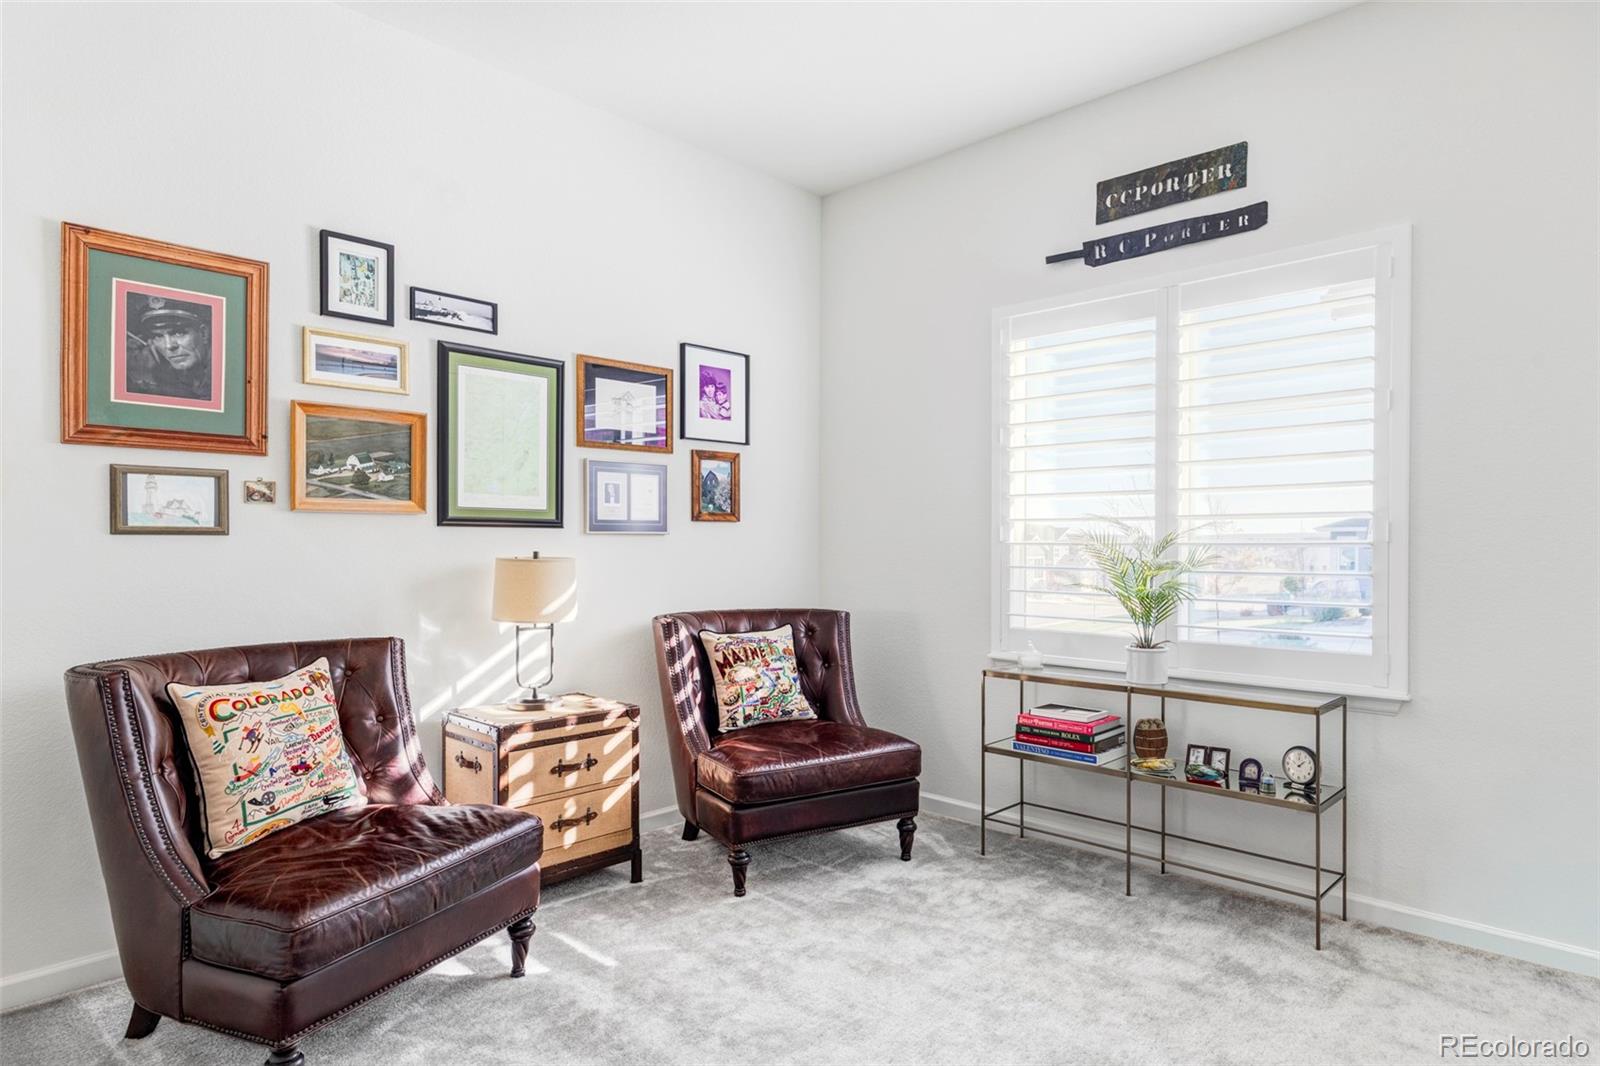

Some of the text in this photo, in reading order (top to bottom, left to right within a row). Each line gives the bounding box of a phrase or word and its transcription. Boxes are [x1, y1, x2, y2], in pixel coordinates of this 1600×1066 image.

[714, 645, 766, 679] MAINE
[209, 686, 315, 722] COLORADO
[265, 736, 281, 745] VAIL
[1061, 732, 1080, 741] ROLEX
[1015, 743, 1051, 755] VALENTINO
[232, 818, 242, 831] 4
